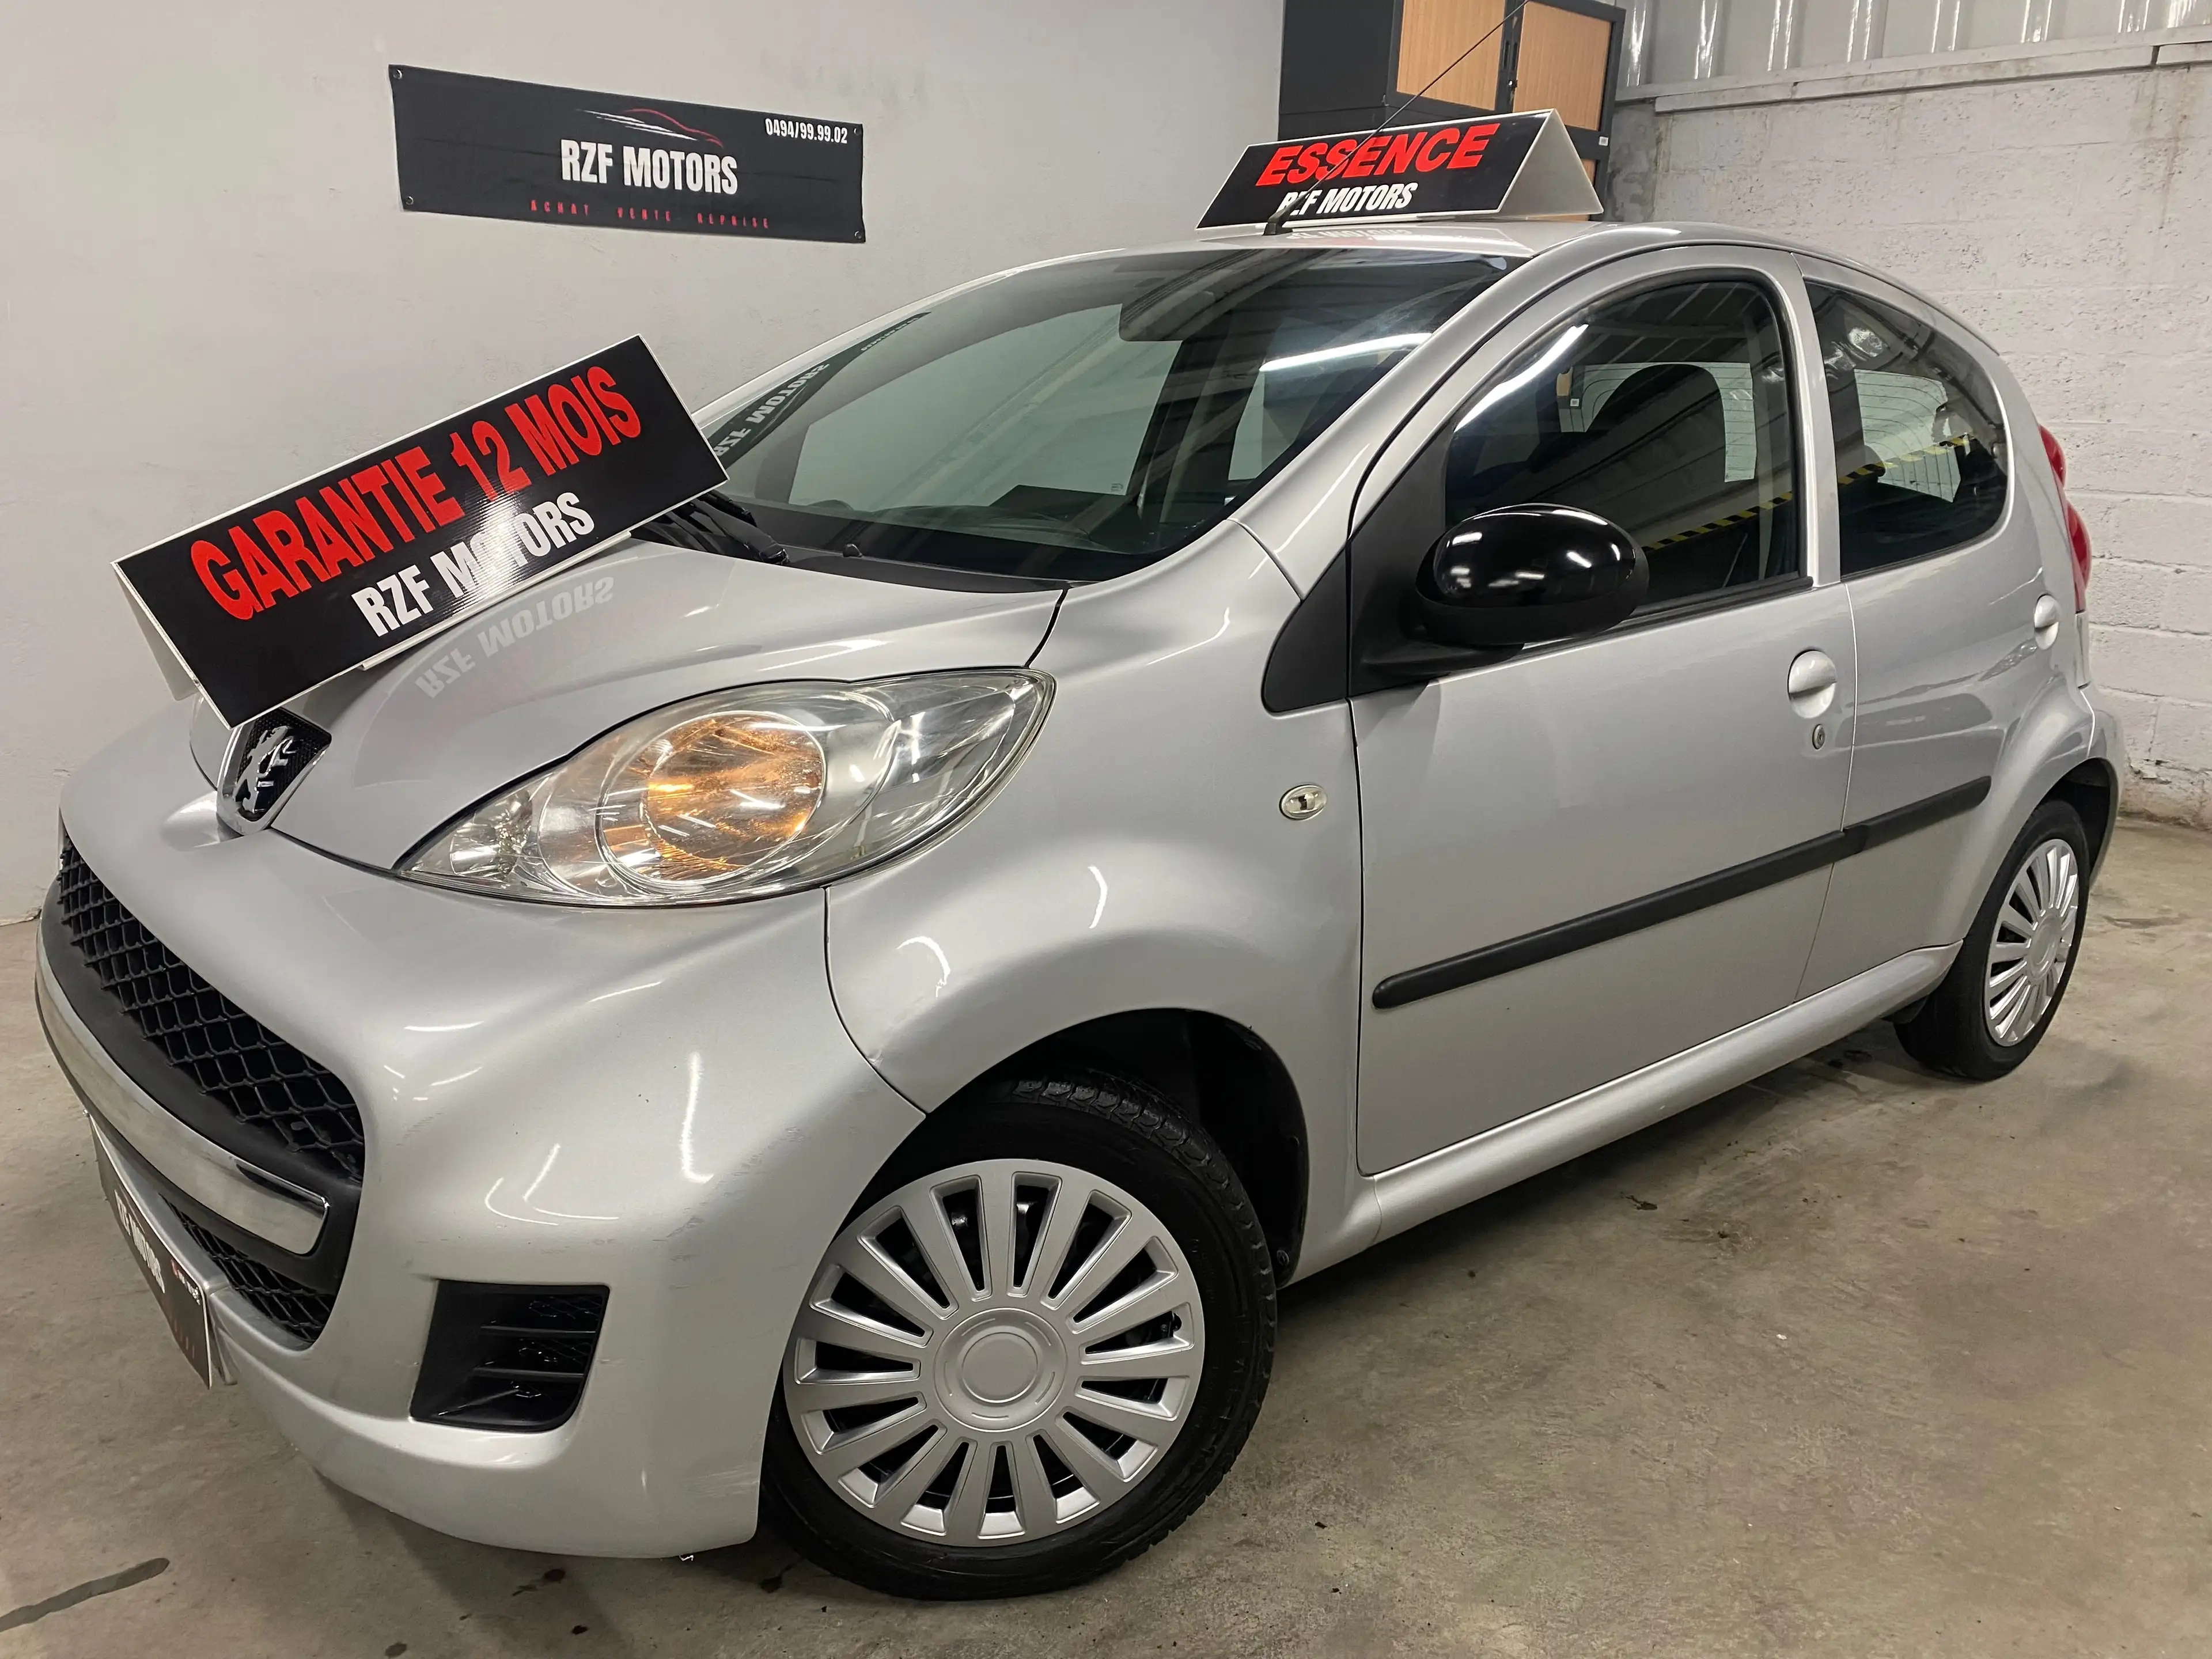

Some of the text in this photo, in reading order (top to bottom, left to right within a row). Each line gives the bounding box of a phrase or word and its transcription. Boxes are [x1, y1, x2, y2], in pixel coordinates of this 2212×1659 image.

[765, 118, 848, 144] 0494/99.99.02
[1255, 122, 1501, 187] ESSENCE
[560, 139, 738, 195] RZF MOTORS
[530, 200, 769, 229] ACHAT VENTE REPRISE
[1316, 183, 1418, 214] MOTORS
[191, 366, 641, 620] GARANTIE 12 MOIS
[351, 565, 433, 637] RZF
